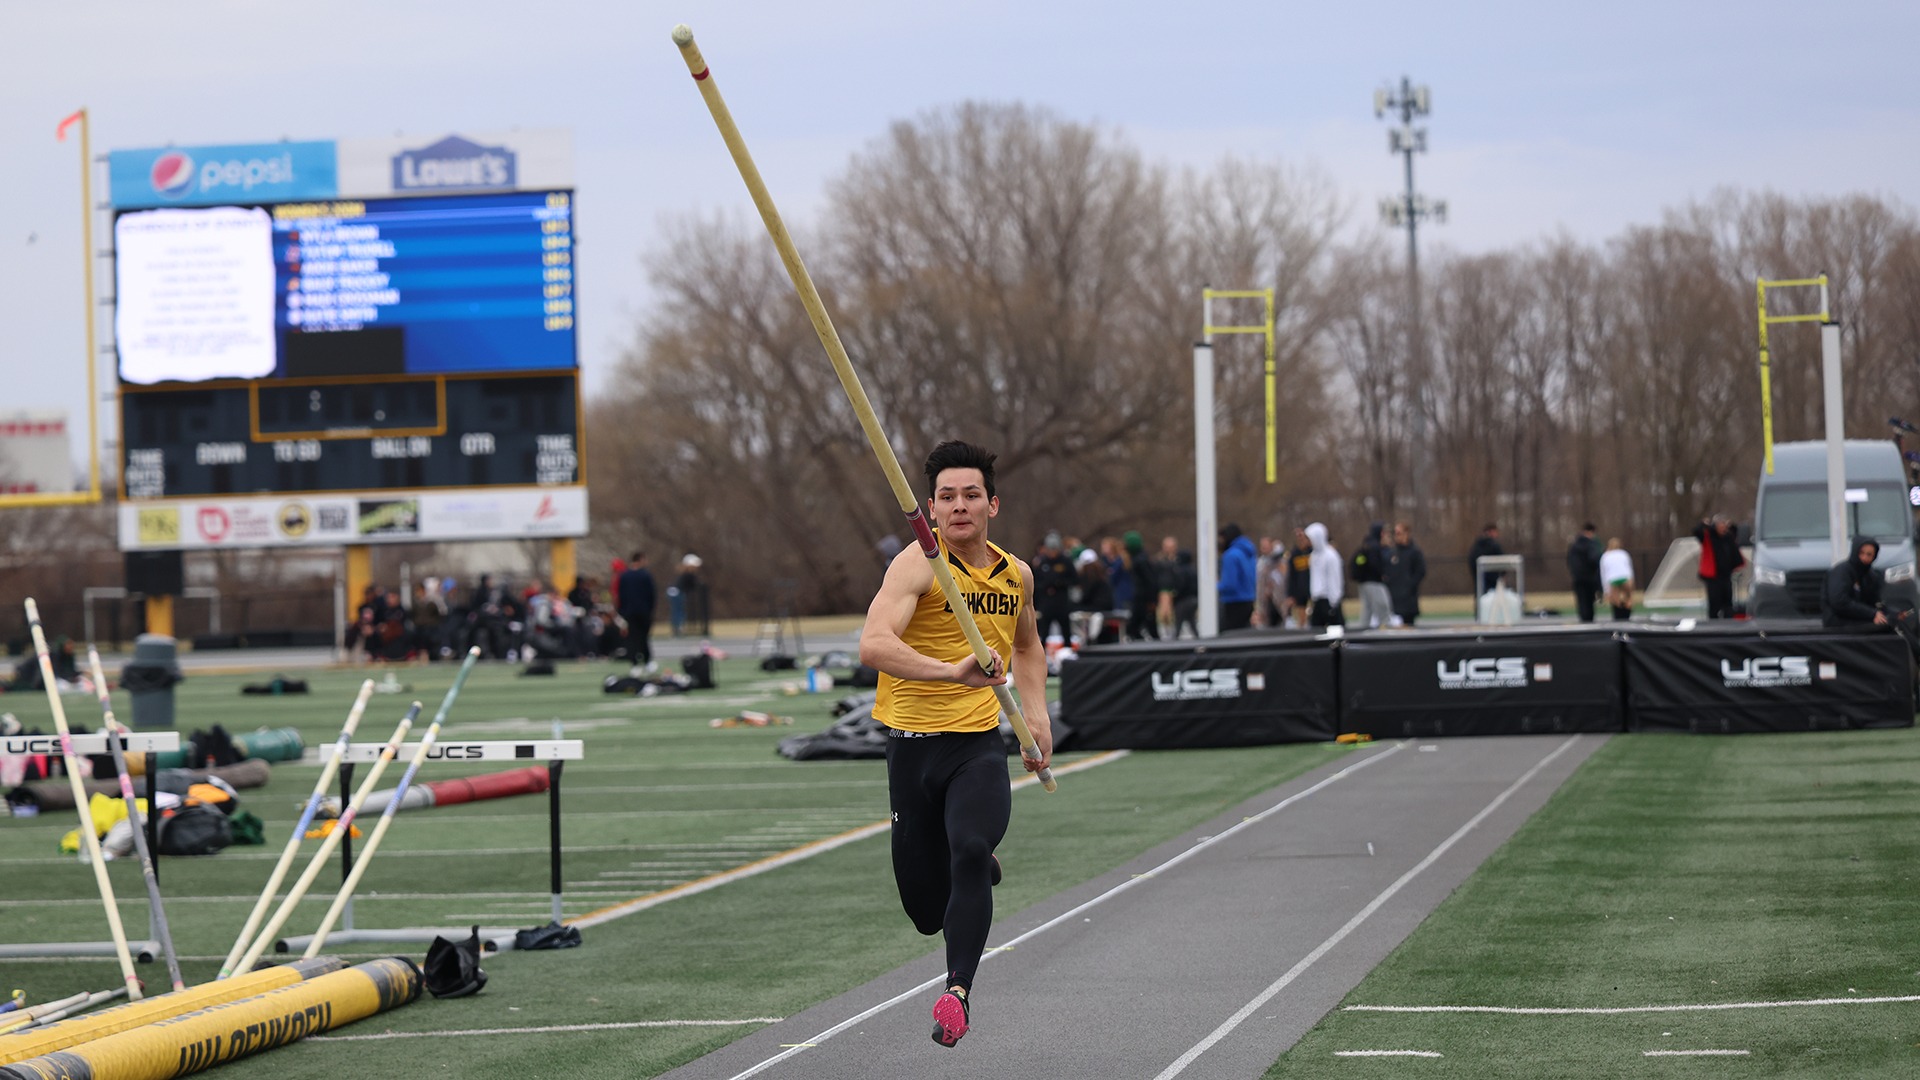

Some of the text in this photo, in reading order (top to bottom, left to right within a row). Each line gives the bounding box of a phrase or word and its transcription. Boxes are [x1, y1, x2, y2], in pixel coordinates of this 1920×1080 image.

[201, 151, 293, 193] pepsi
[944, 592, 1019, 616] HKOSH
[1437, 657, 1527, 681] UCS
[1721, 656, 1811, 679] UCS
[1151, 669, 1241, 693] UCS
[427, 745, 483, 759] UCS
